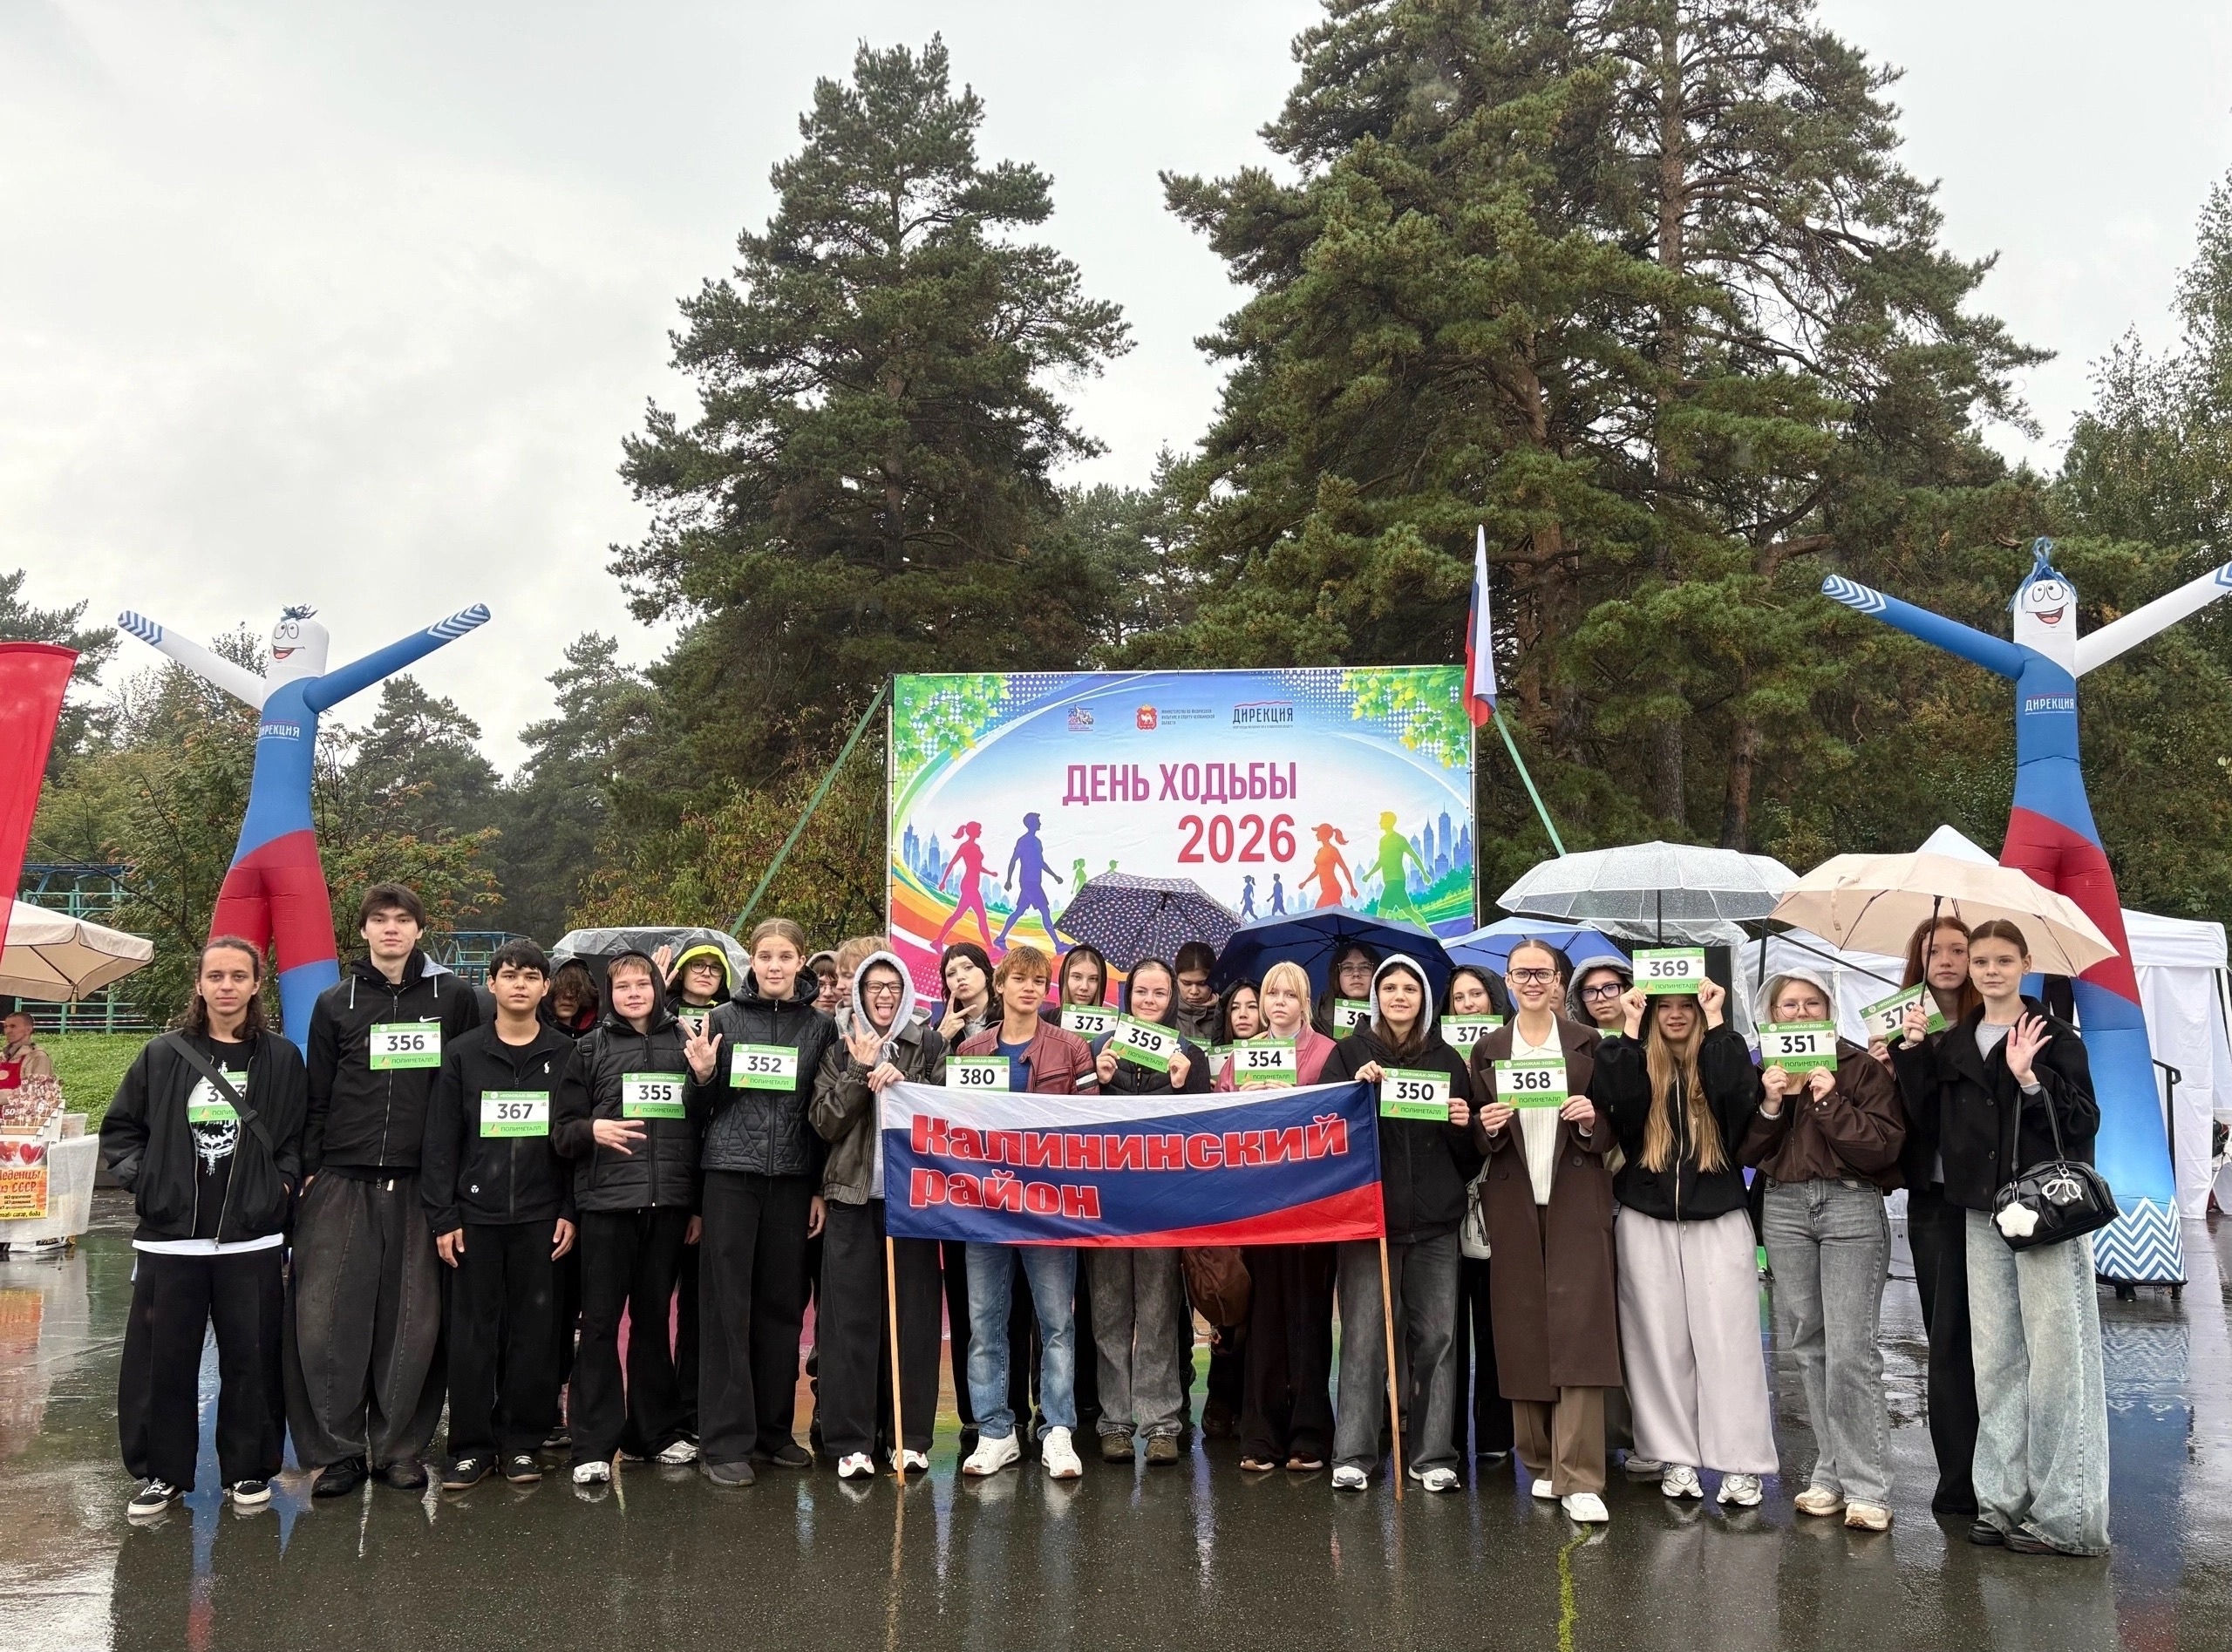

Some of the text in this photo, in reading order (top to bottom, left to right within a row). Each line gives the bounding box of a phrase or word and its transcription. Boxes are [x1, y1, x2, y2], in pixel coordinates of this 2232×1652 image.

[2024, 698, 2074, 712] ДИРЕКЦИЯ
[1232, 707, 1293, 724] ДИРЕКЦИЯ
[1062, 761, 1297, 806] ДЕНЬ ХОДЬБЫ
[1177, 813, 1296, 864] 2026
[1650, 960, 1689, 976] 369
[1074, 1016, 1104, 1031] 373
[387, 1035, 425, 1051] 356
[1127, 1028, 1161, 1051] 359
[1780, 1035, 1815, 1053] 351
[747, 1056, 782, 1073] 352
[1127, 1050, 1164, 1066] ПОЛИМЕТАЛЛ
[1249, 1050, 1282, 1067] 354
[960, 1068, 995, 1084] 380
[1512, 1071, 1551, 1090] 368
[638, 1084, 672, 1101] 355
[1396, 1082, 1434, 1101] 350
[497, 1103, 534, 1119] 367
[910, 1112, 1349, 1170] Калининский
[909, 1167, 1101, 1219] район
